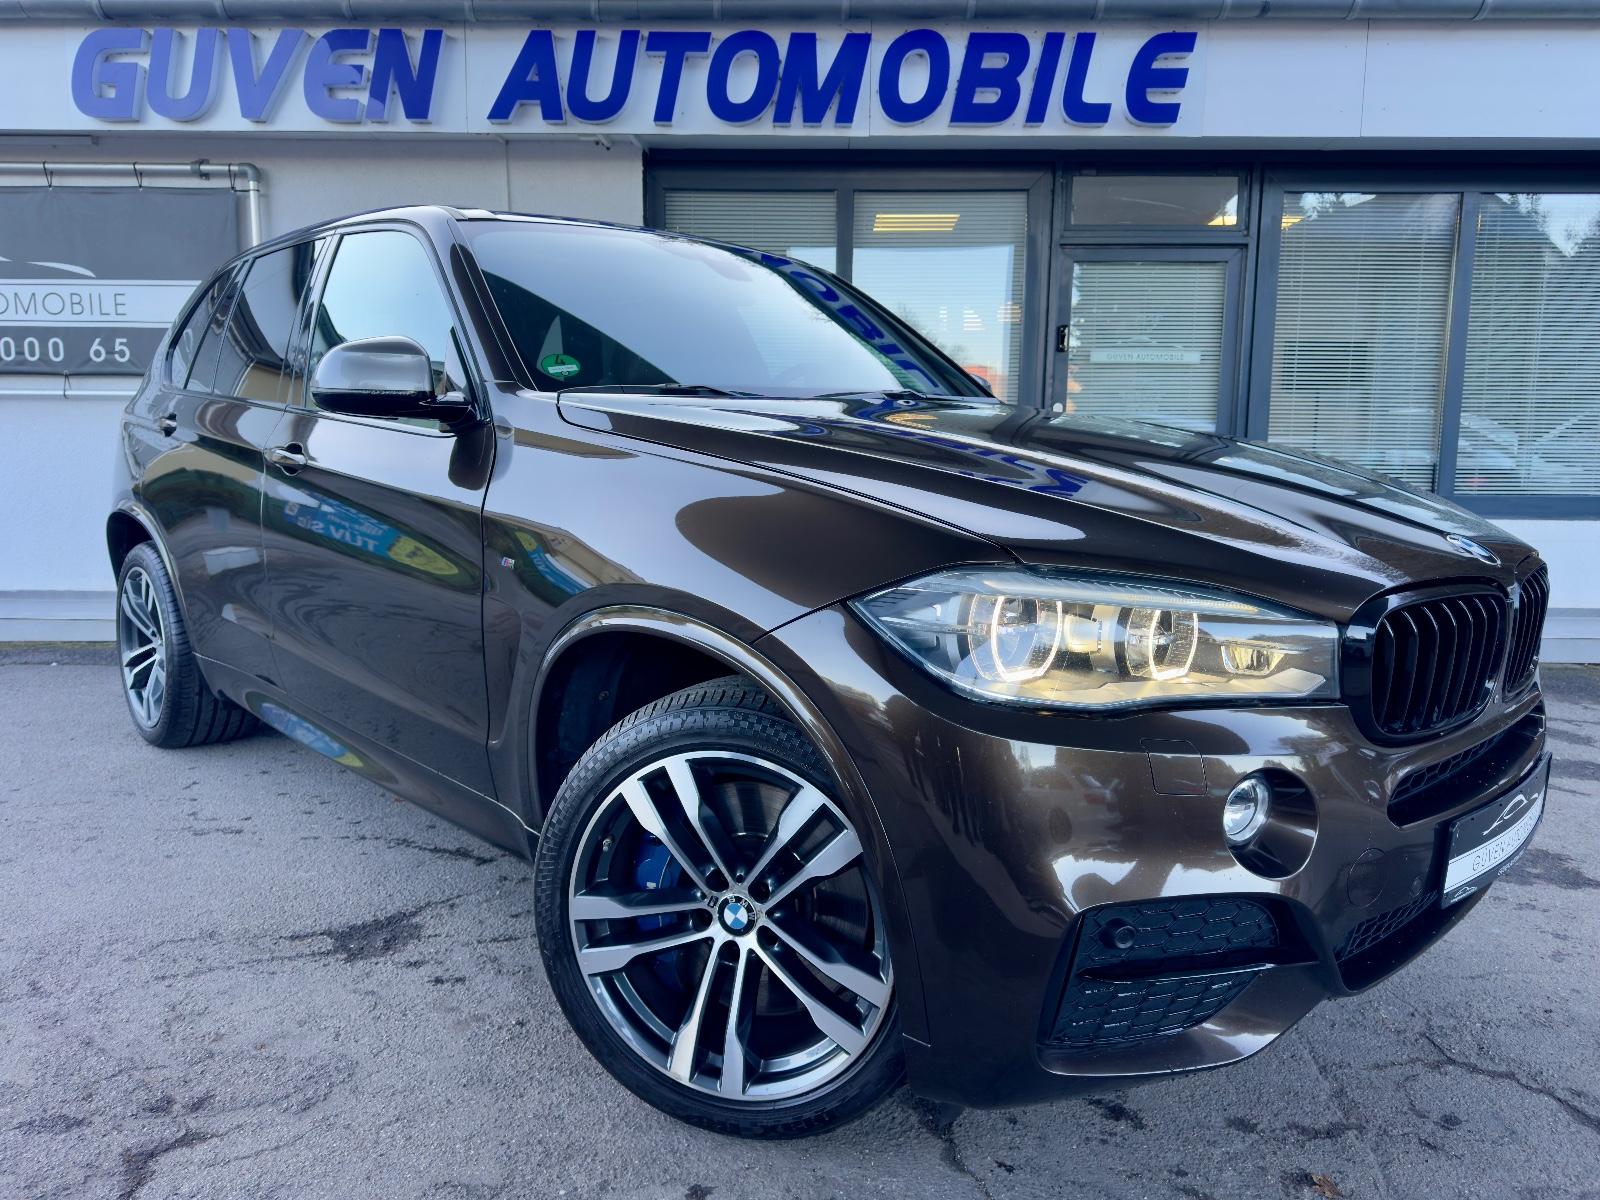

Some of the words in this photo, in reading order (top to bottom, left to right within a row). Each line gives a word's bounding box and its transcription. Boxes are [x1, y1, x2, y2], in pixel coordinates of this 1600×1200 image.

[71, 27, 445, 123] GUVEN
[486, 29, 1198, 126] AUTOMOBILE
[89, 337, 131, 362] 65
[1136, 352, 1185, 361] AUTOMOBILE
